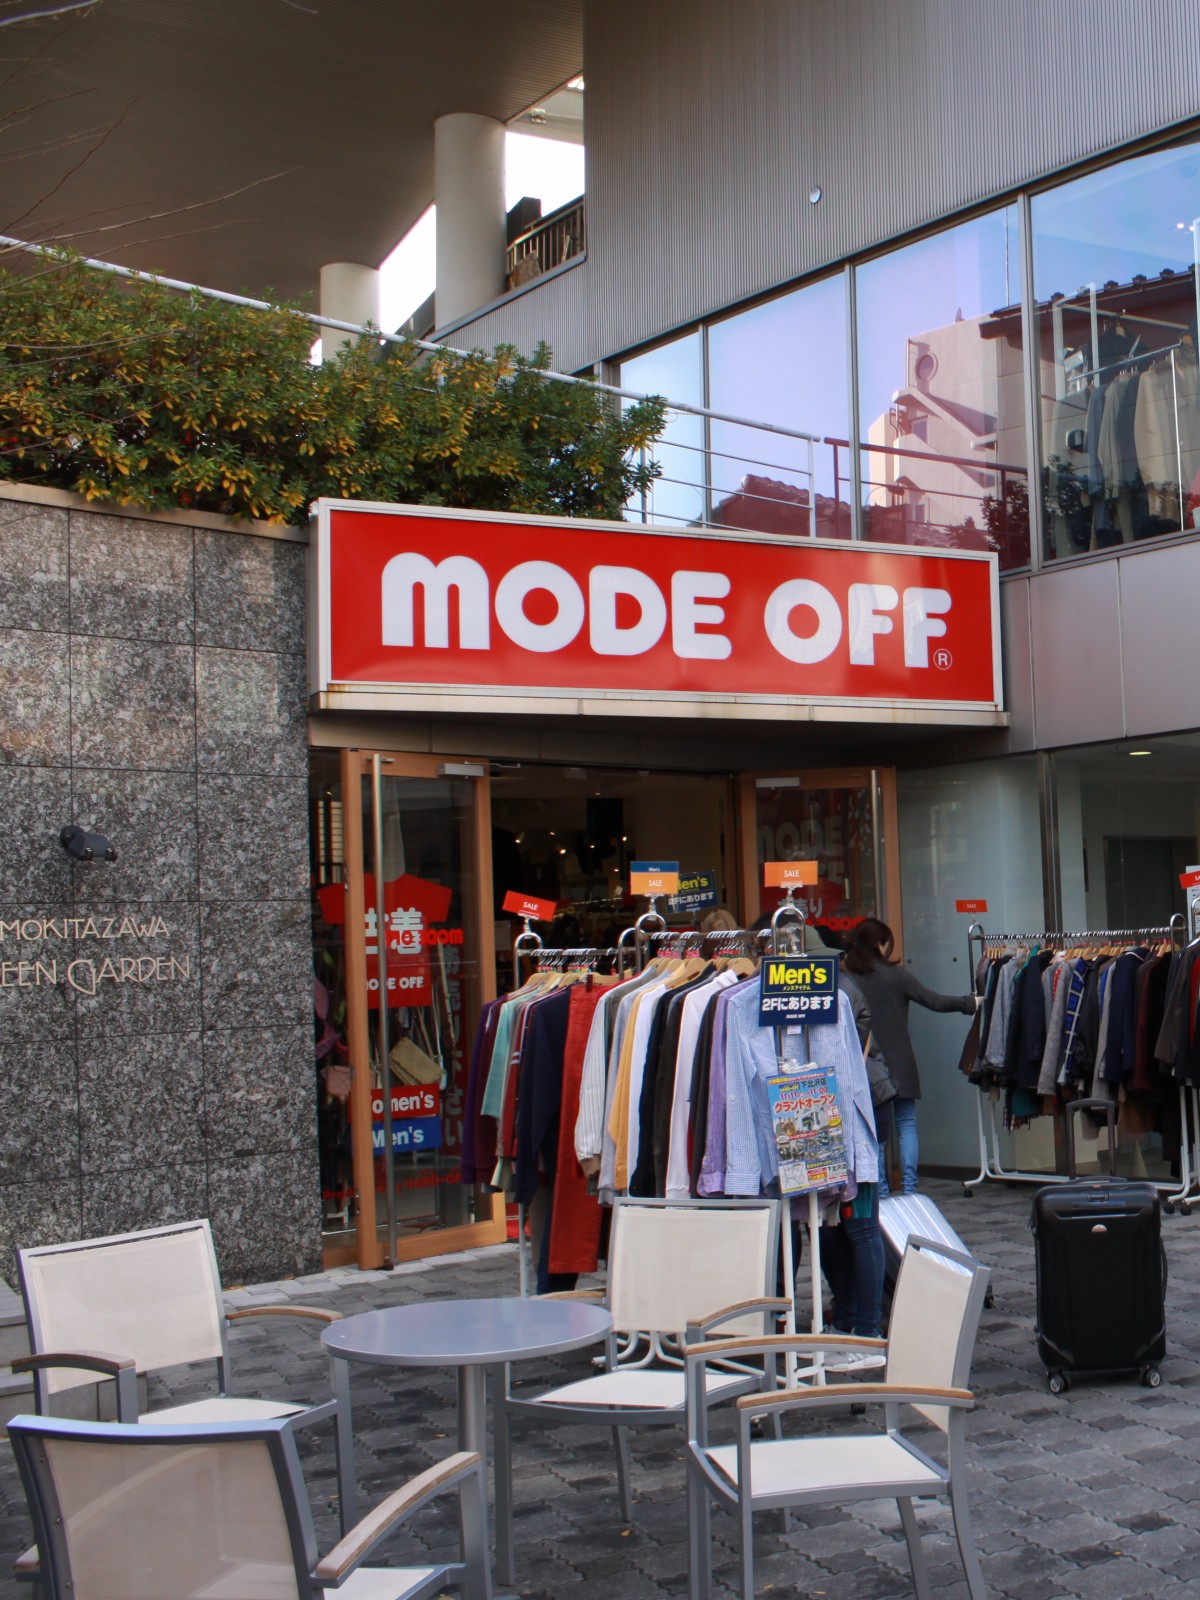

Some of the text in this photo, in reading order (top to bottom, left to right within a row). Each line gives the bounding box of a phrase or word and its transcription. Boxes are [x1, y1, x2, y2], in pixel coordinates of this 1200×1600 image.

[381, 551, 952, 669] MODE OFF
[784, 870, 800, 878] SALE
[648, 879, 663, 887] SALE
[678, 876, 708, 890] en's
[523, 901, 539, 911] SALE
[0, 955, 190, 996] EEN GARDEN
[769, 963, 827, 985] Men's
[399, 976, 424, 989] OFF
[762, 996, 833, 1011] 2Fにあります
[371, 1091, 434, 1114] omen's
[775, 1094, 836, 1114] グランドオープン
